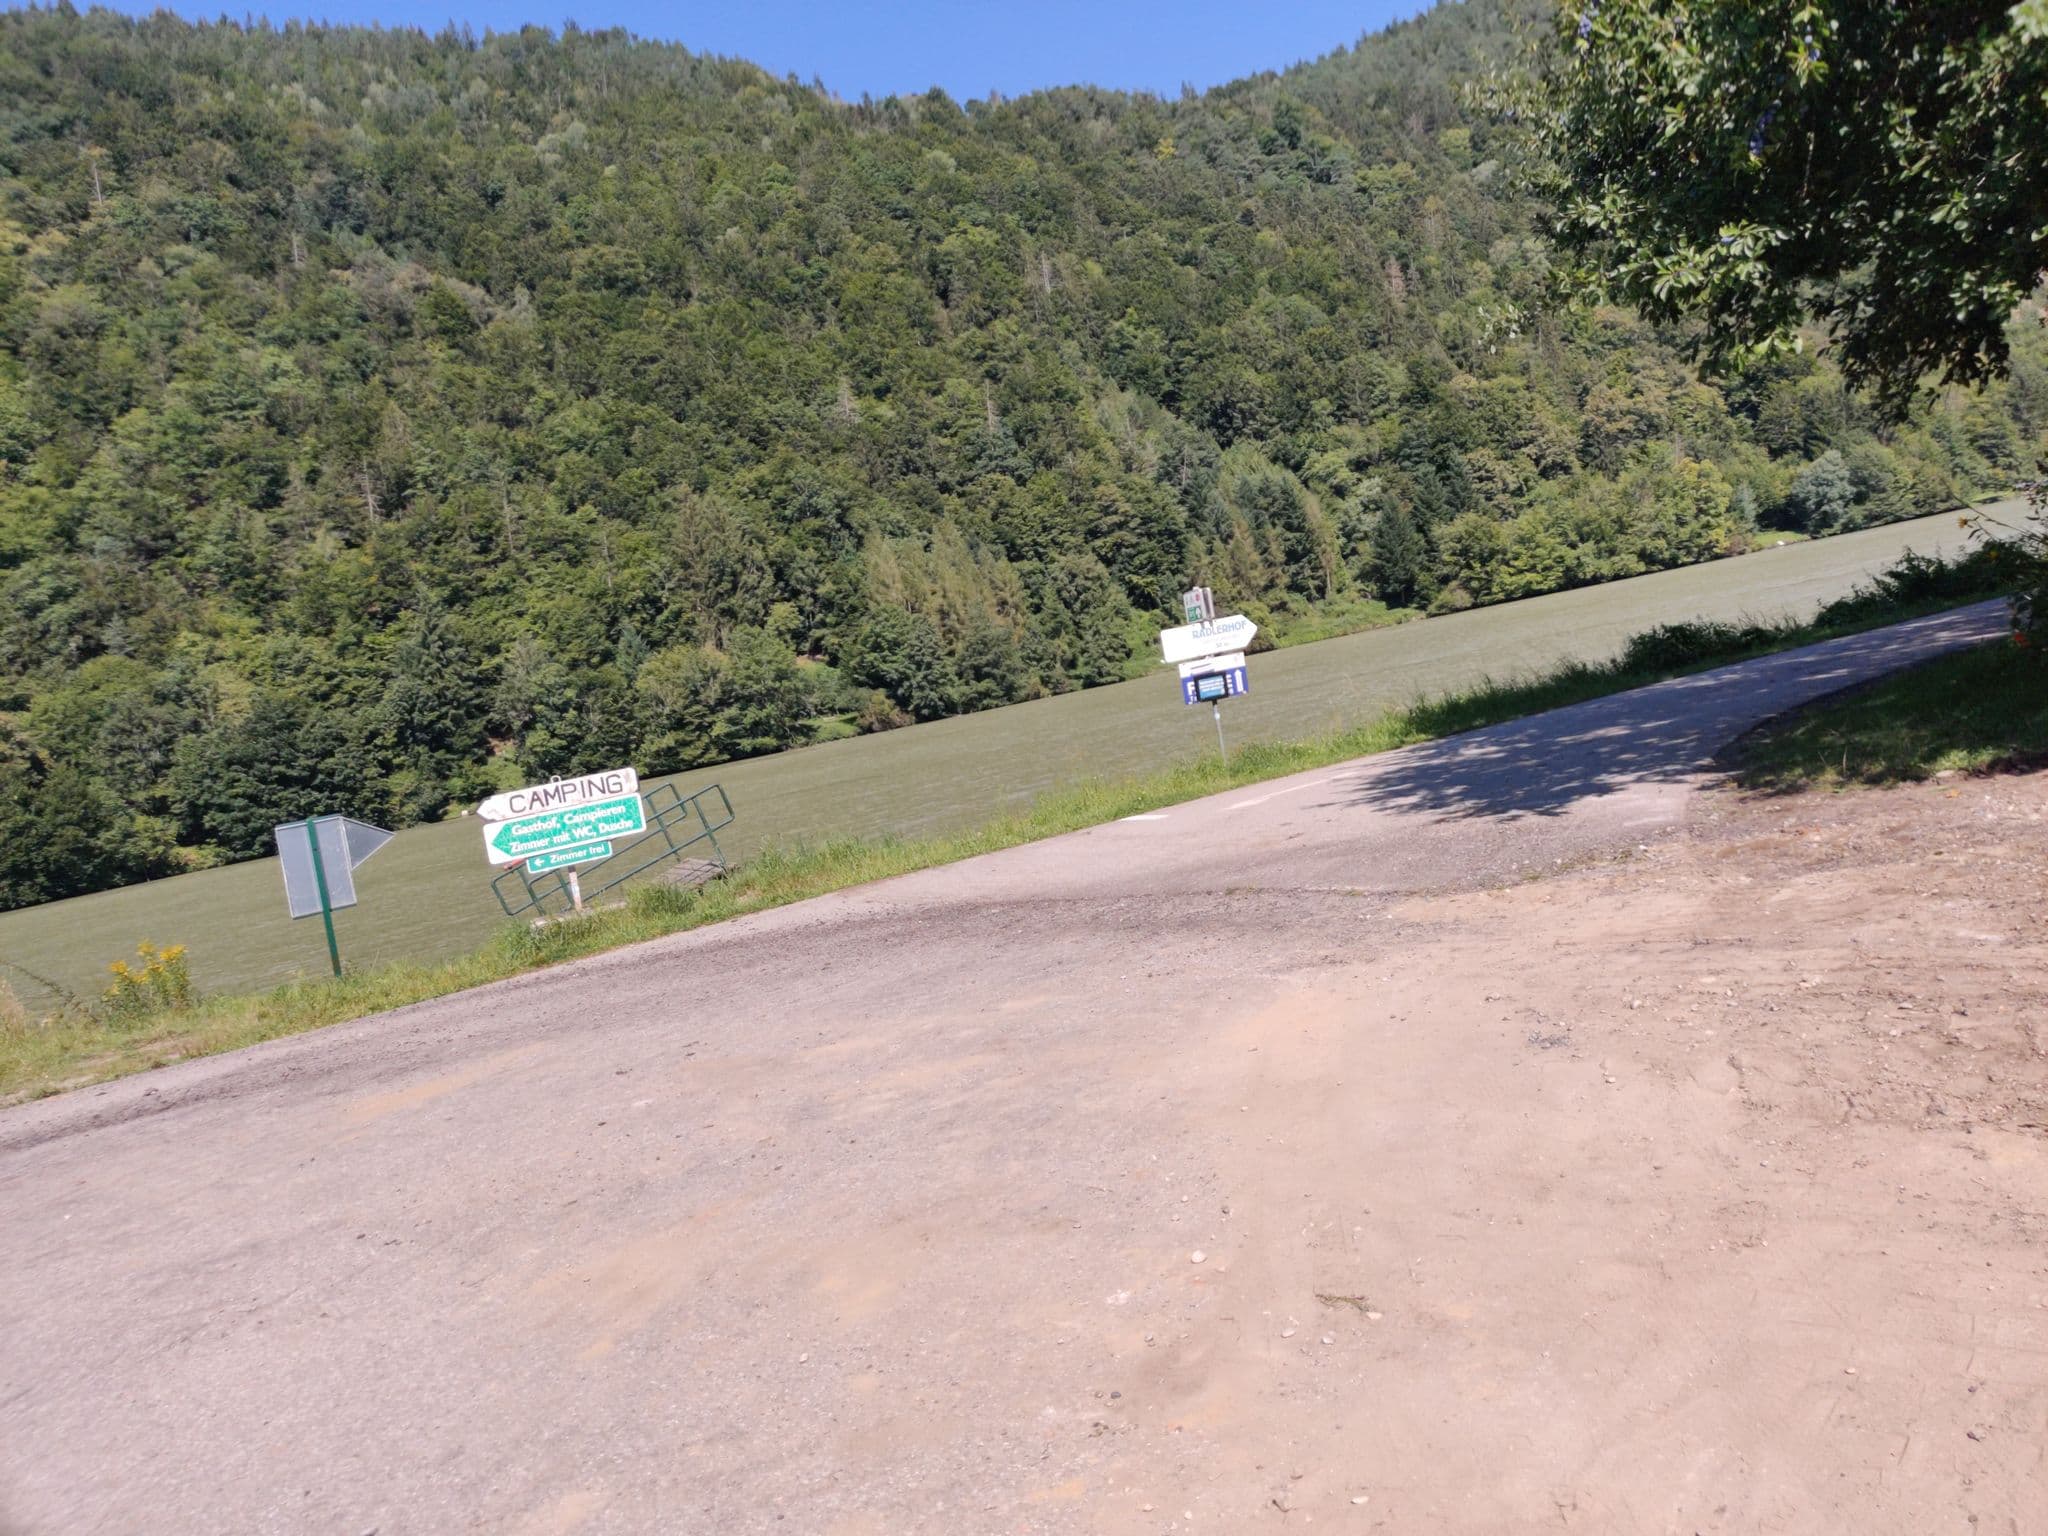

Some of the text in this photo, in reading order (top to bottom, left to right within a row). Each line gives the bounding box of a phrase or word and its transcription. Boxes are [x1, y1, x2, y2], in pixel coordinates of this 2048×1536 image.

[510, 774, 623, 814] CAMPING
[564, 805, 626, 824] Campieren
[509, 839, 549, 855] Zimmer
[553, 833, 570, 845] mit
[598, 819, 634, 832] Dusche
[550, 844, 605, 861] Zimmer frei
